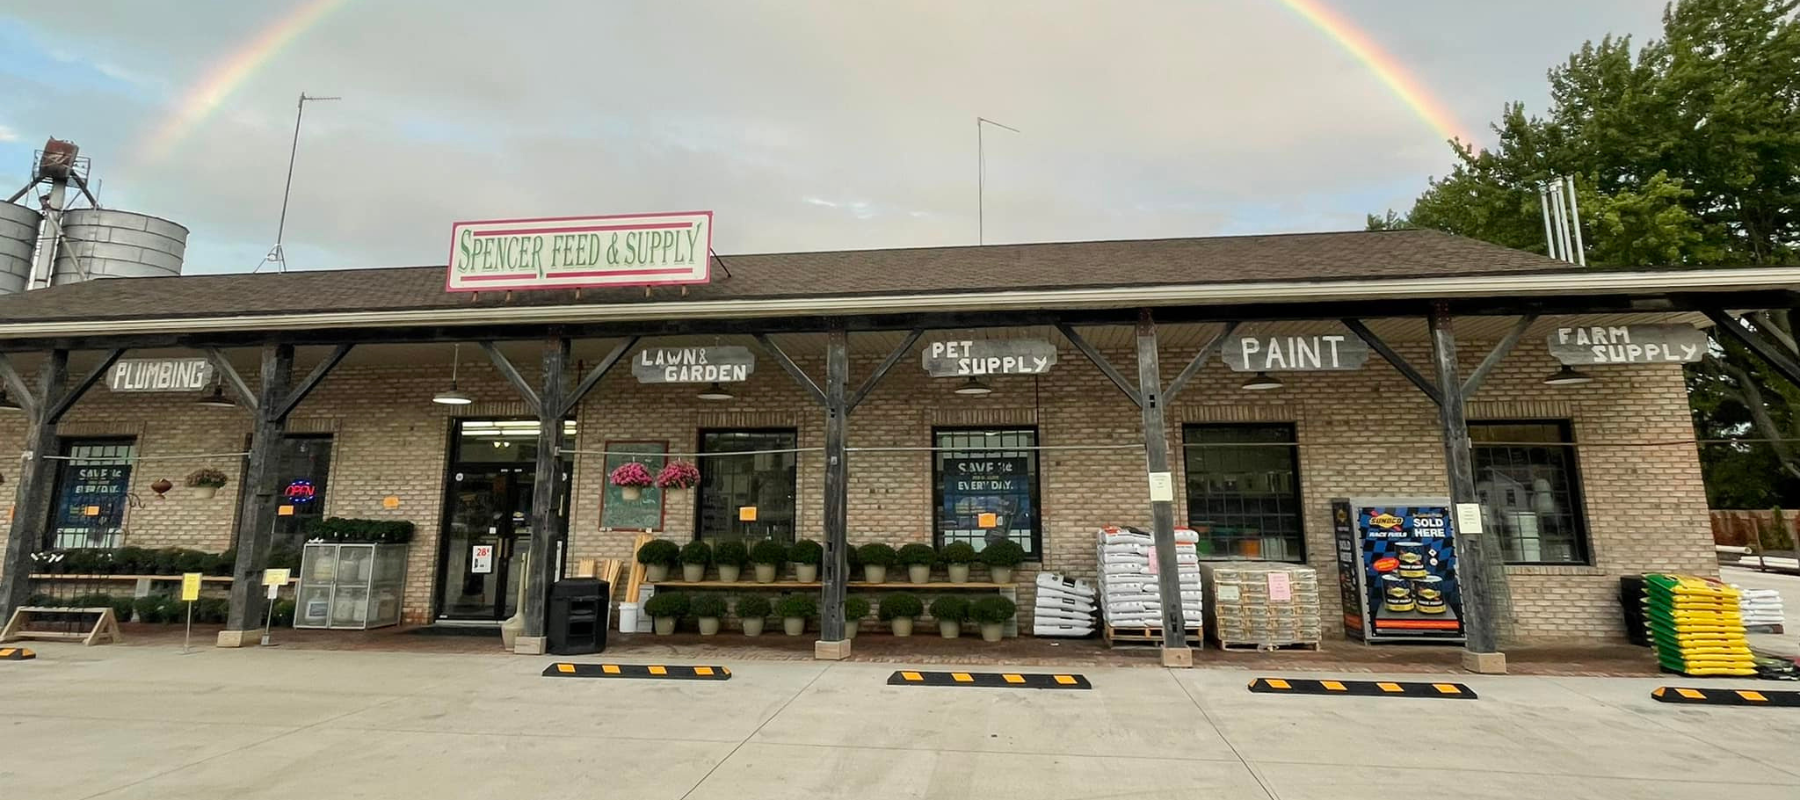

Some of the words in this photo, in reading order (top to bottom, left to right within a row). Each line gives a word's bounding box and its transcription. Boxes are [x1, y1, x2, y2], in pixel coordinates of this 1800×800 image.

[458, 229, 543, 278] SPENCER
[551, 233, 600, 267] FEED
[606, 231, 620, 265] &
[624, 222, 702, 265] SUPPLY
[1558, 326, 1631, 345] FARM
[932, 341, 973, 358] PET
[1241, 336, 1344, 369] PAINT
[1591, 344, 1697, 362] SUPPLY
[665, 364, 747, 382] GARDEN
[958, 356, 1047, 374] SUPPLY
[113, 361, 205, 389] PLUMBING
[284, 485, 315, 496] OPEN
[1369, 517, 1402, 525] SUNOCO
[1413, 518, 1444, 527] SOLD
[1414, 528, 1446, 537] HERE
